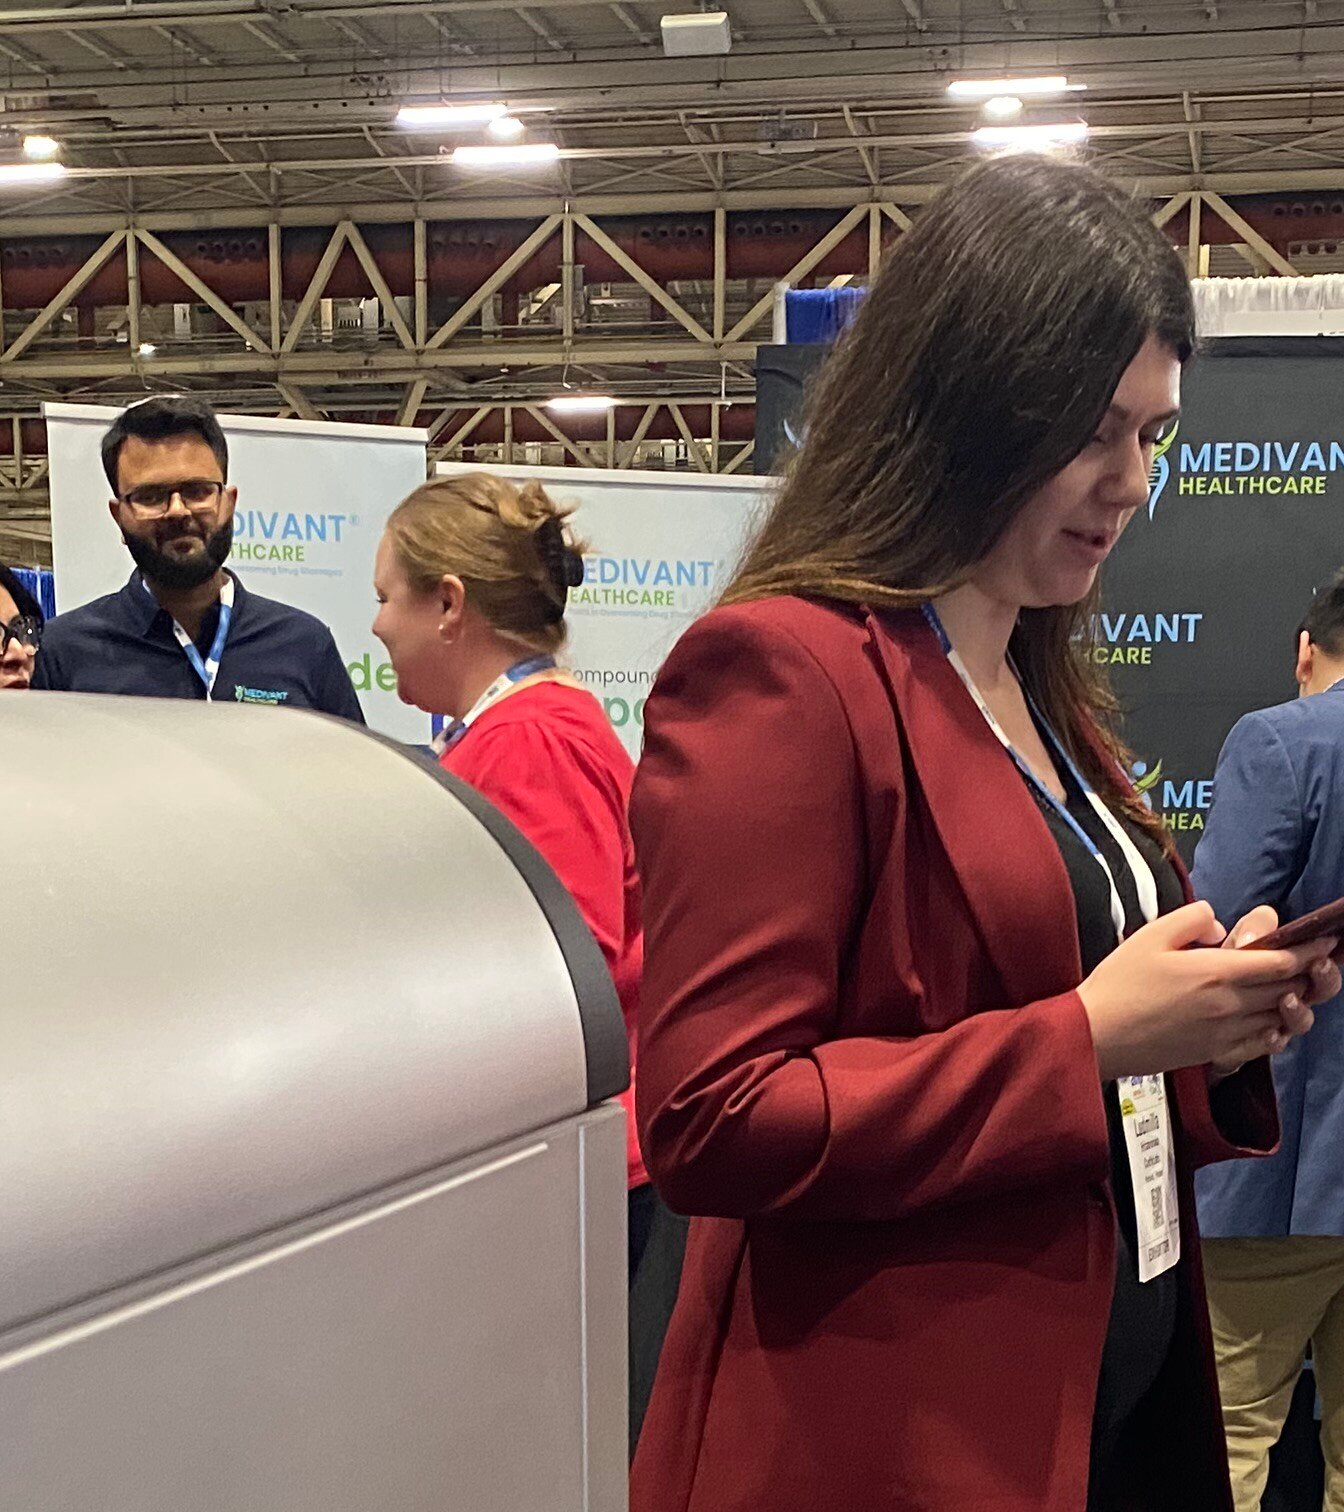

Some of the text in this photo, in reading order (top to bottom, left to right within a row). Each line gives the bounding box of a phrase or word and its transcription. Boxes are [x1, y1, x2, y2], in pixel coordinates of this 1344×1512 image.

[1178, 475, 1327, 496] HEALTHCARE
[1162, 780, 1215, 808] ME
[1162, 813, 1205, 830] HEA
